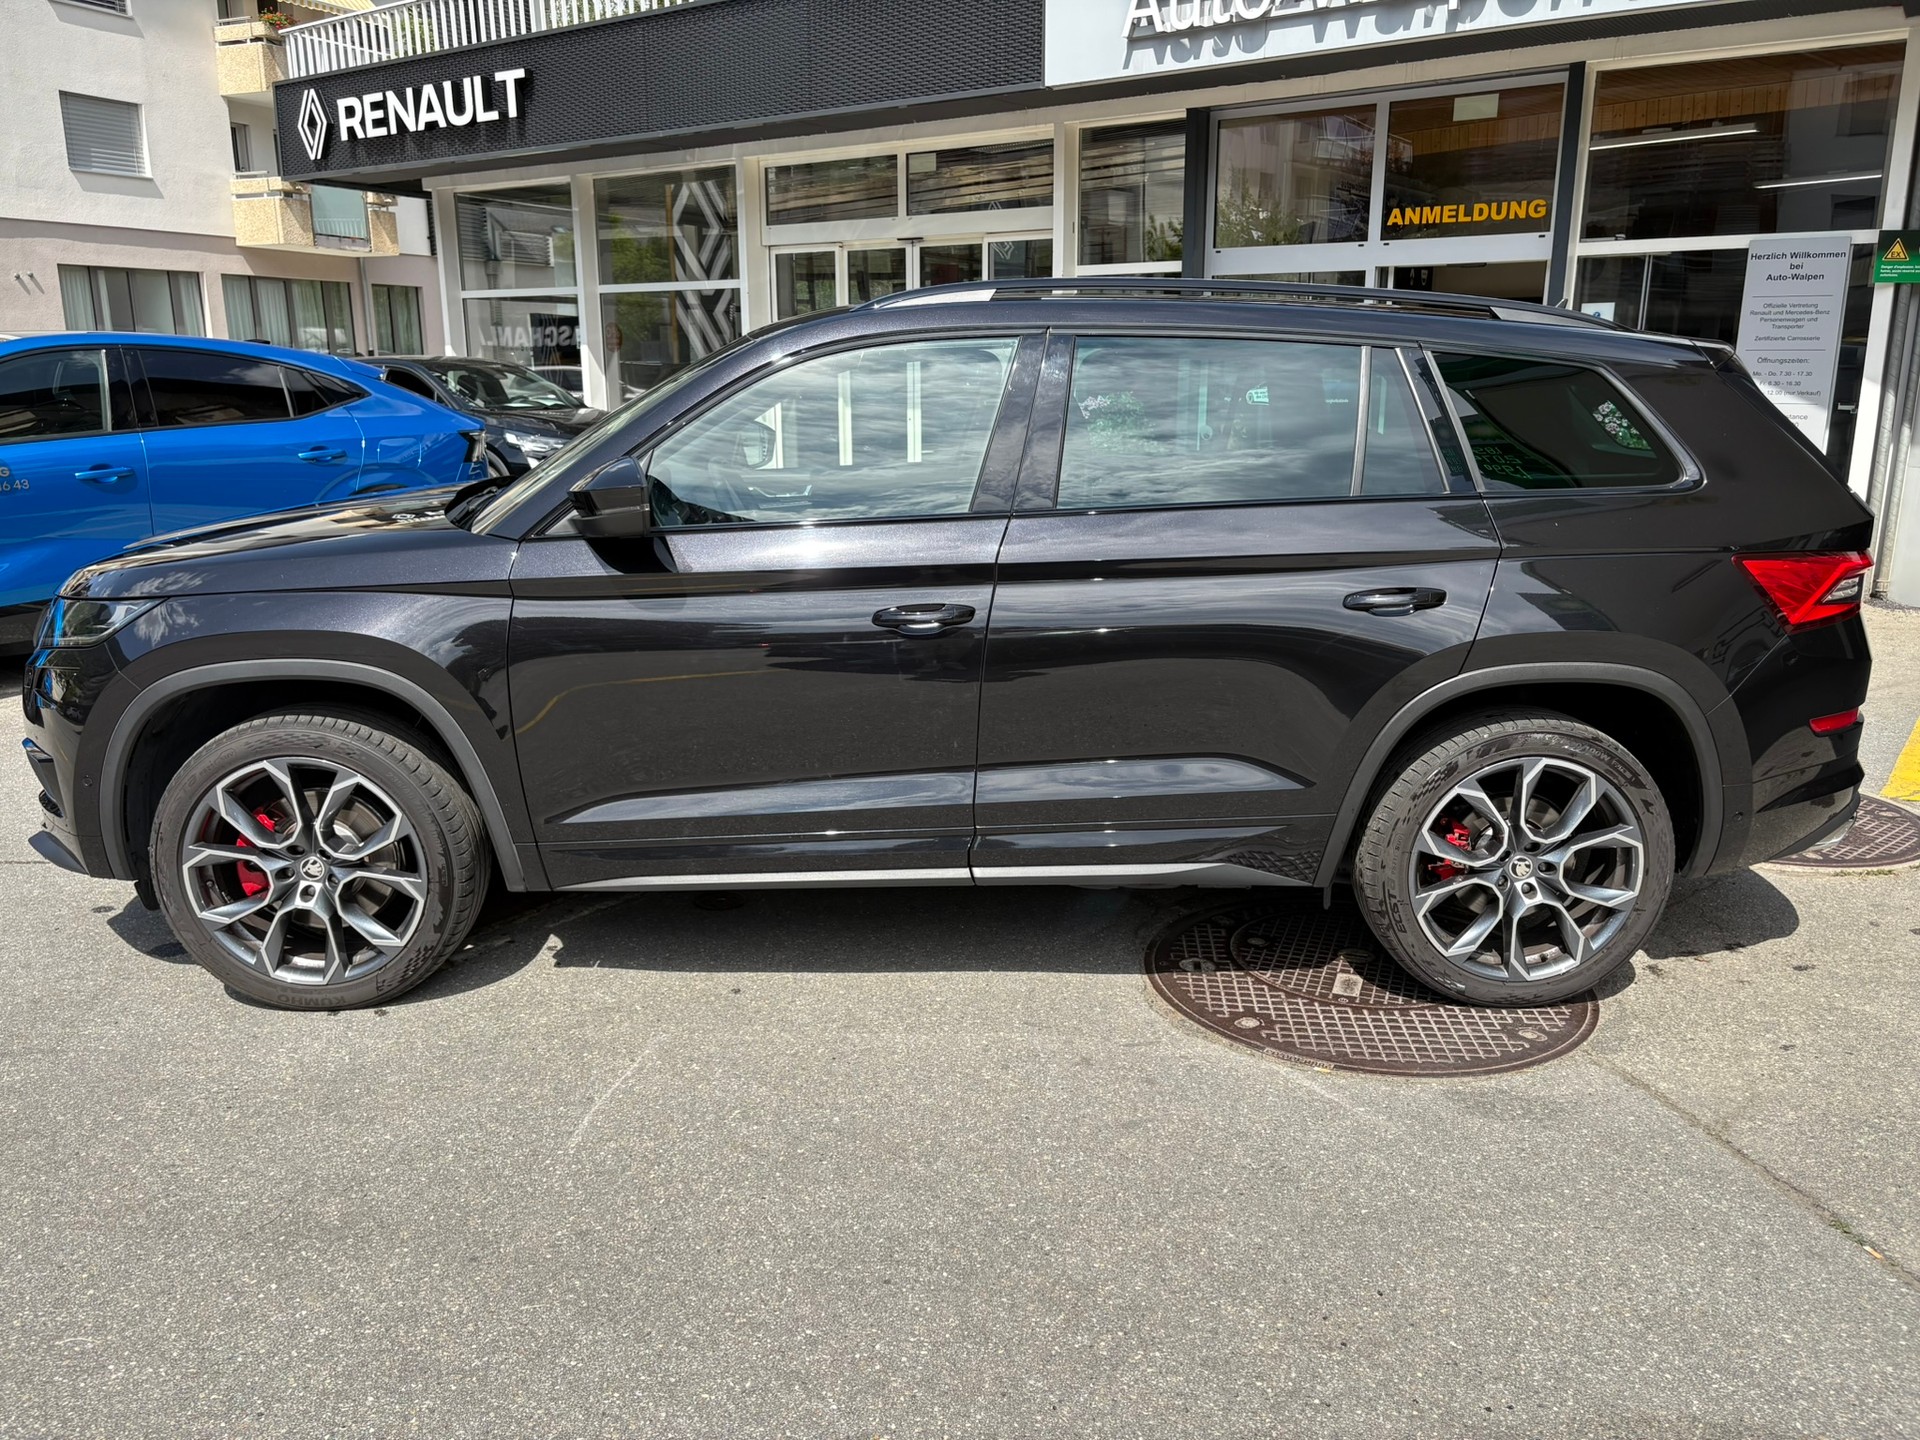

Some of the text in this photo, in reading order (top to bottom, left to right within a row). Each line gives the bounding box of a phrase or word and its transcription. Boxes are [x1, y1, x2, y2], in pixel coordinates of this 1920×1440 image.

[336, 68, 525, 141] RENAULT
[1387, 199, 1547, 225] ANMELDUNG
[1750, 251, 1846, 260] Herzlich Willkommen
[1789, 262, 1803, 270] bei
[1766, 273, 1824, 282] Auto-Walpen
[14, 479, 29, 490] 43
